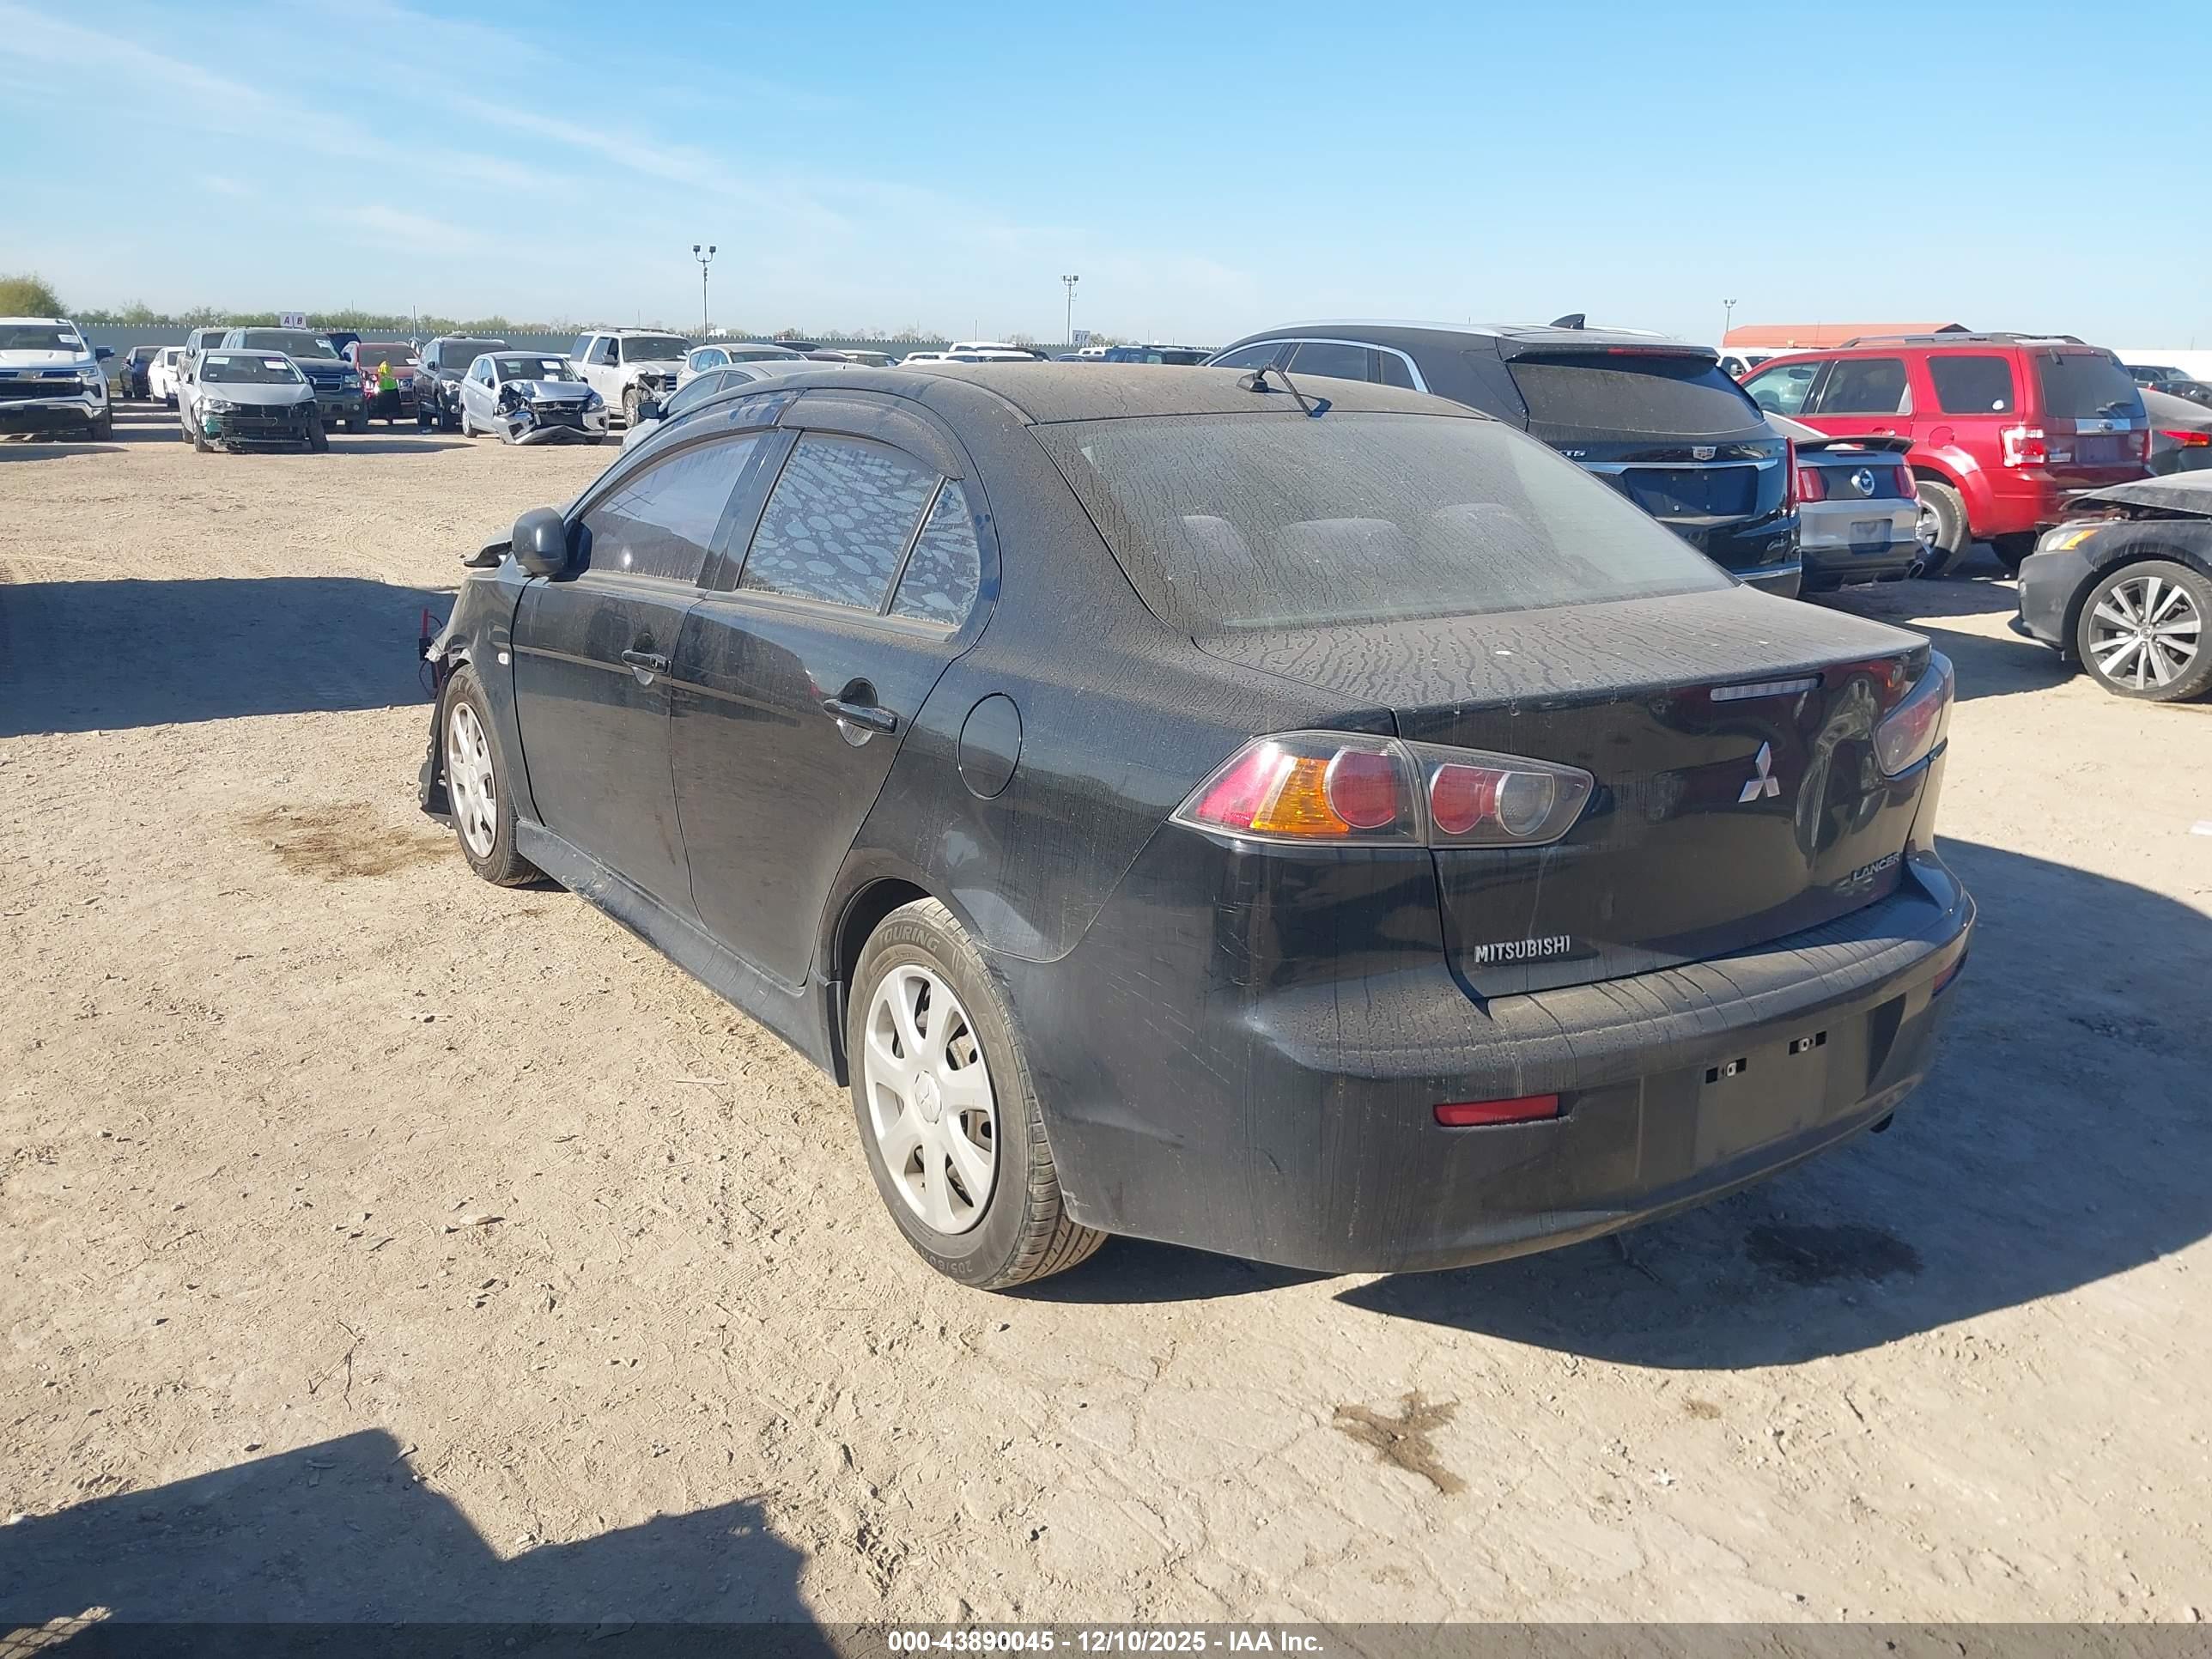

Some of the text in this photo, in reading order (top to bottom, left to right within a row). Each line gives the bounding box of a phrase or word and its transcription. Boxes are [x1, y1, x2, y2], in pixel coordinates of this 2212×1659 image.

[284, 316, 303, 325] A B
[1851, 851, 1900, 881] LANCER
[878, 927, 941, 952] TOURING
[1474, 934, 1571, 963] MITSUBISHI
